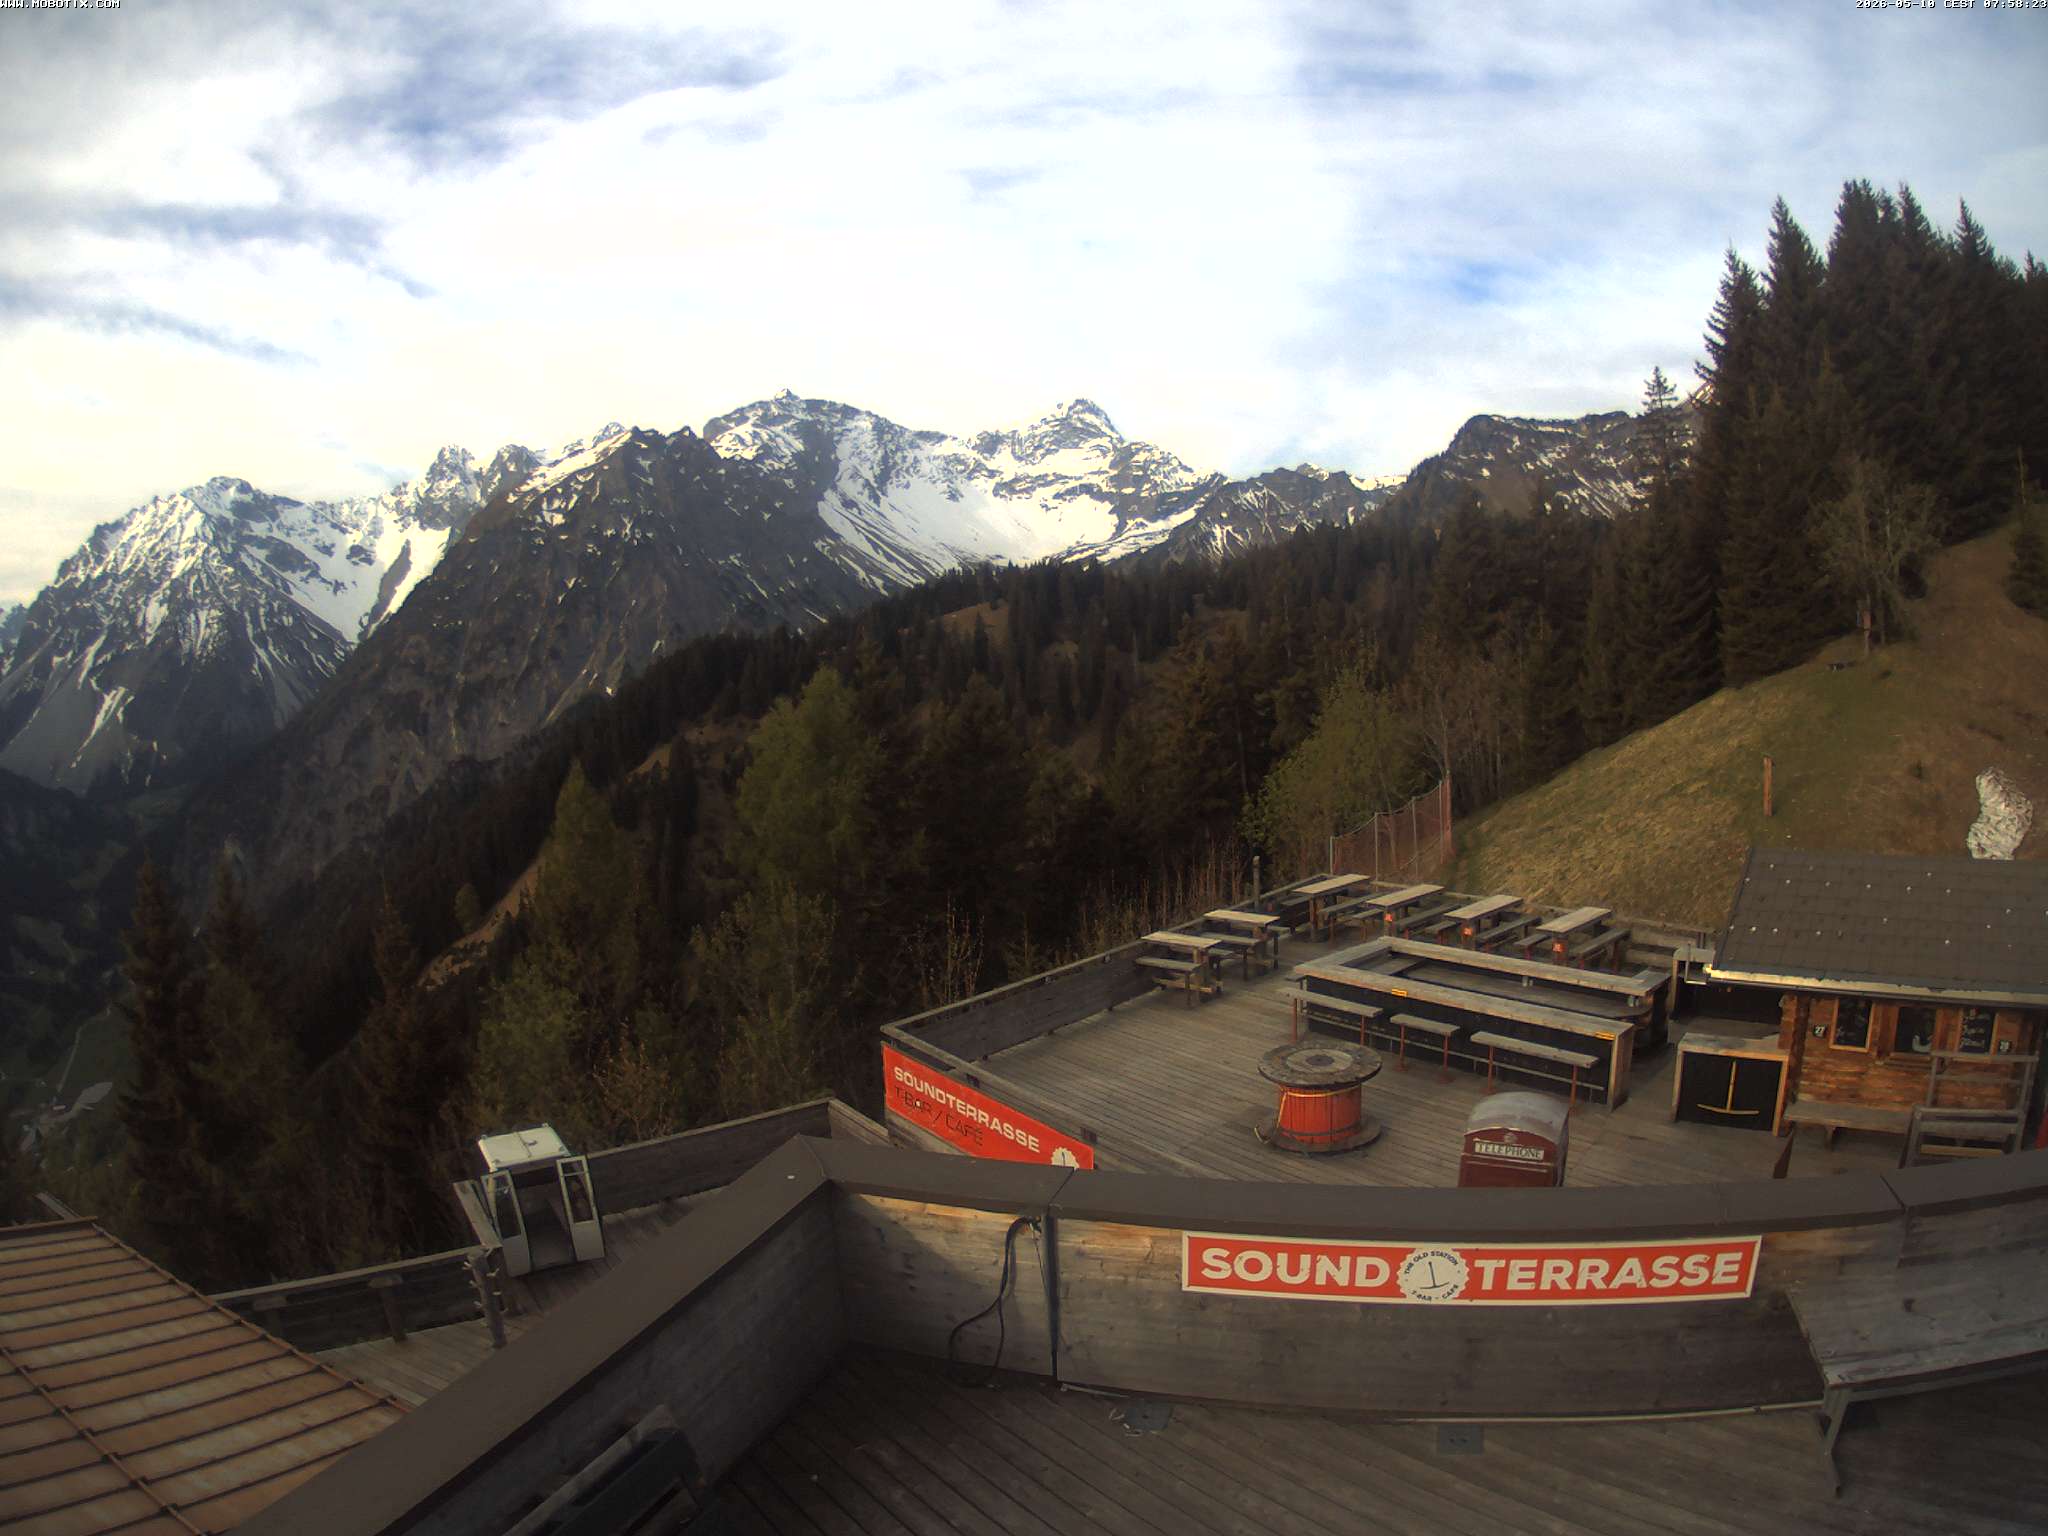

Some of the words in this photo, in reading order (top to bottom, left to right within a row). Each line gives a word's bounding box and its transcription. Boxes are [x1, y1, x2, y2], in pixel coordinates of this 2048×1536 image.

[894, 1066, 1040, 1154] SOUNDTERRASSE
[1477, 1142, 1541, 1159] TELEPHONE
[1201, 1247, 1390, 1288] SOUND
[1413, 1252, 1429, 1263] OLD
[1430, 1250, 1459, 1266] STATION
[1474, 1252, 1743, 1291] TERRASSE
